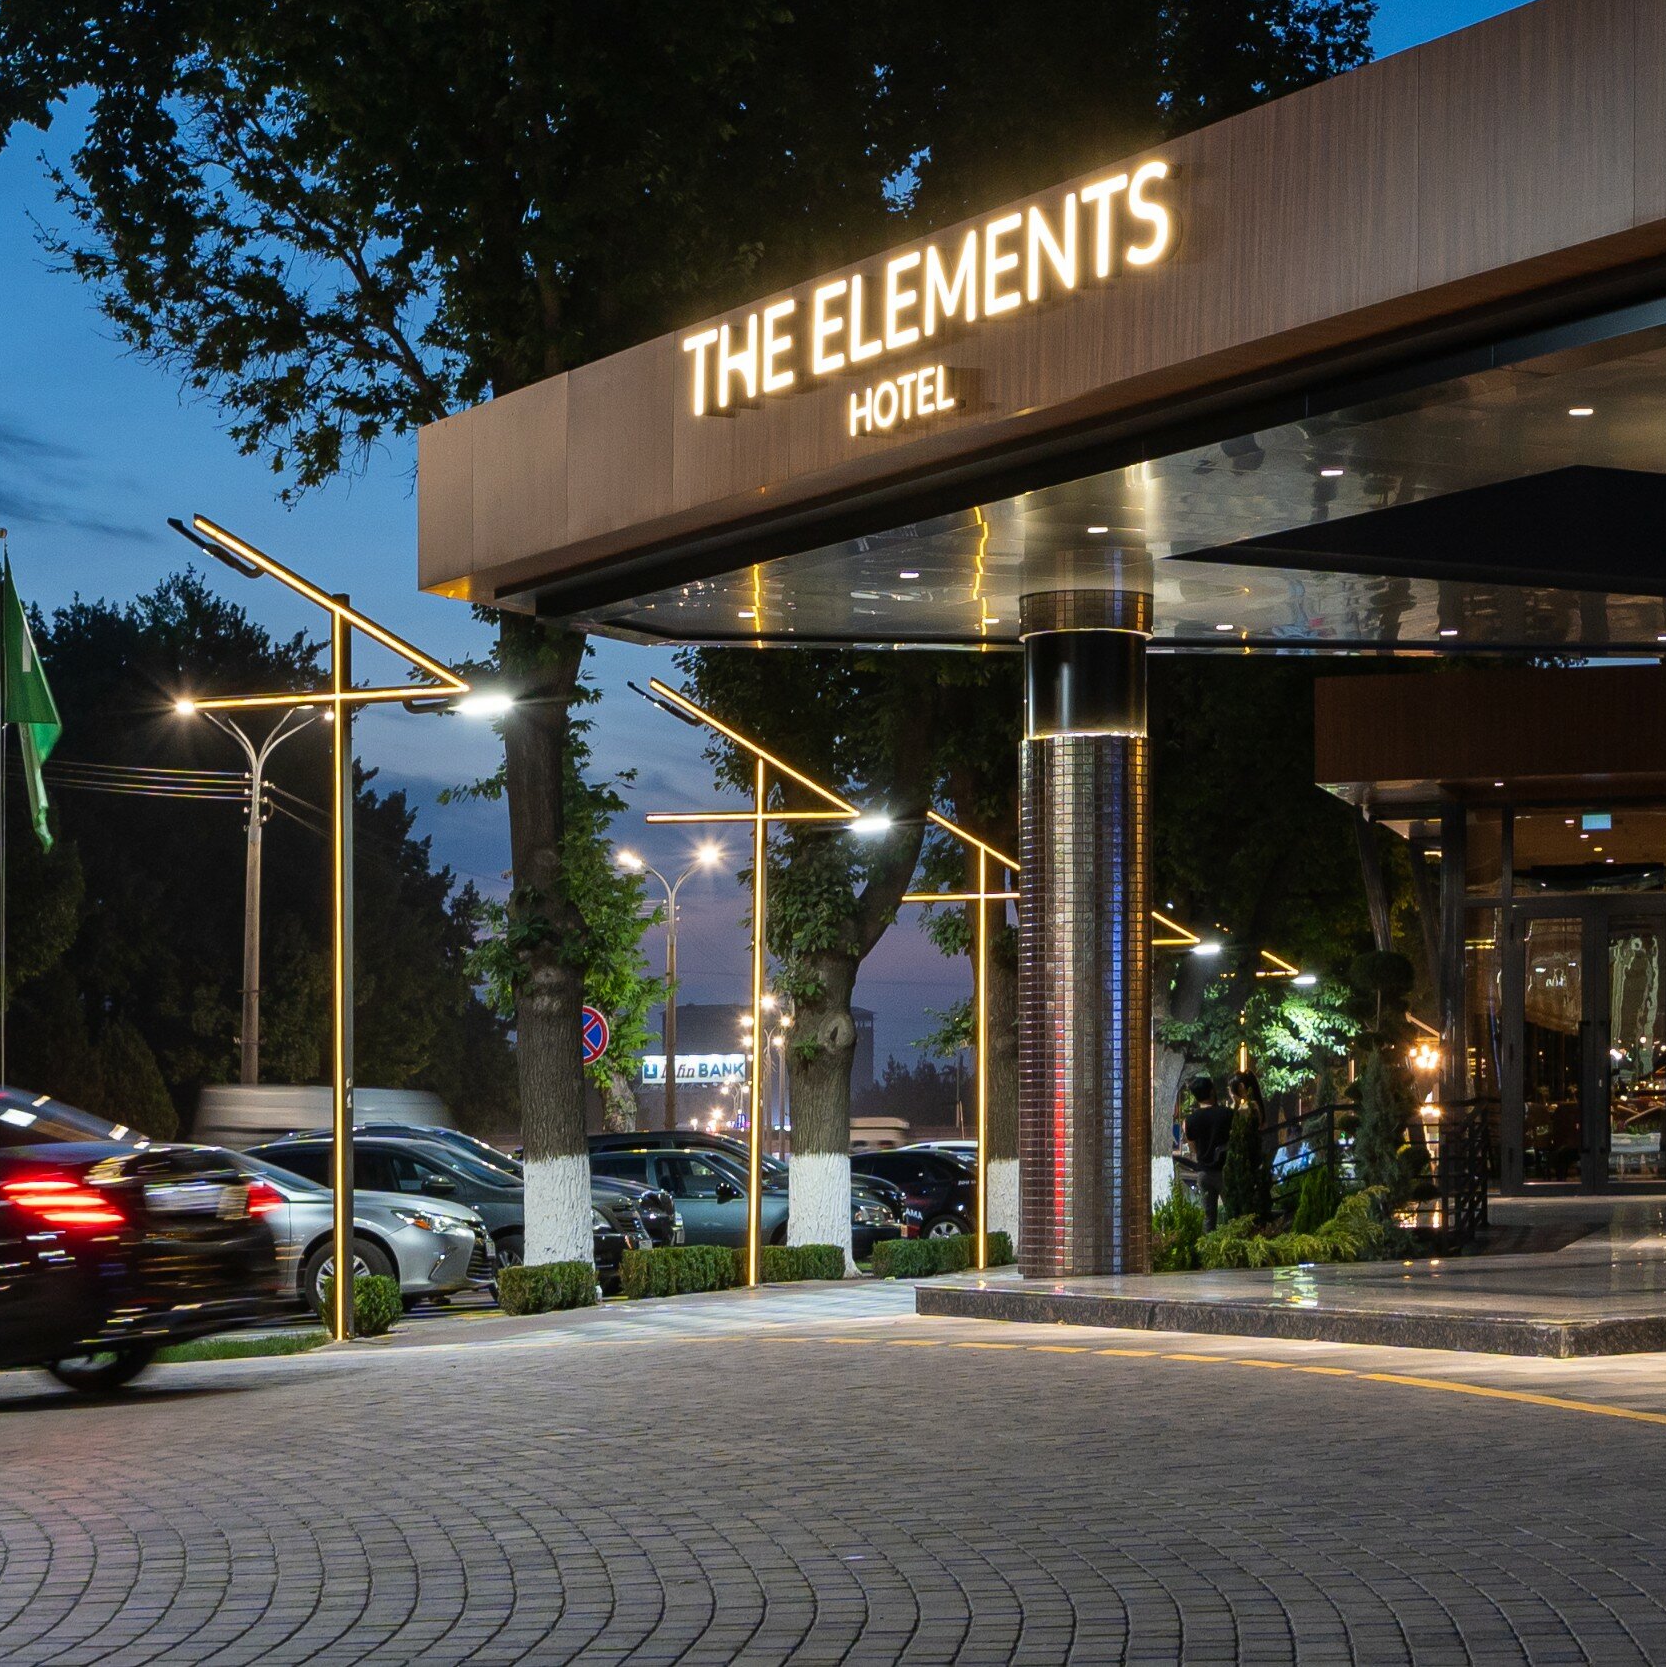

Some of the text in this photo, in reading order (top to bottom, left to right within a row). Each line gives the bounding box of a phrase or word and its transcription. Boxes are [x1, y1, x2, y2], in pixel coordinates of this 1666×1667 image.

[683, 161, 1169, 416] THE ELEMENTS
[849, 365, 955, 436] HOTEL
[661, 1062, 745, 1079] IfinBANK
